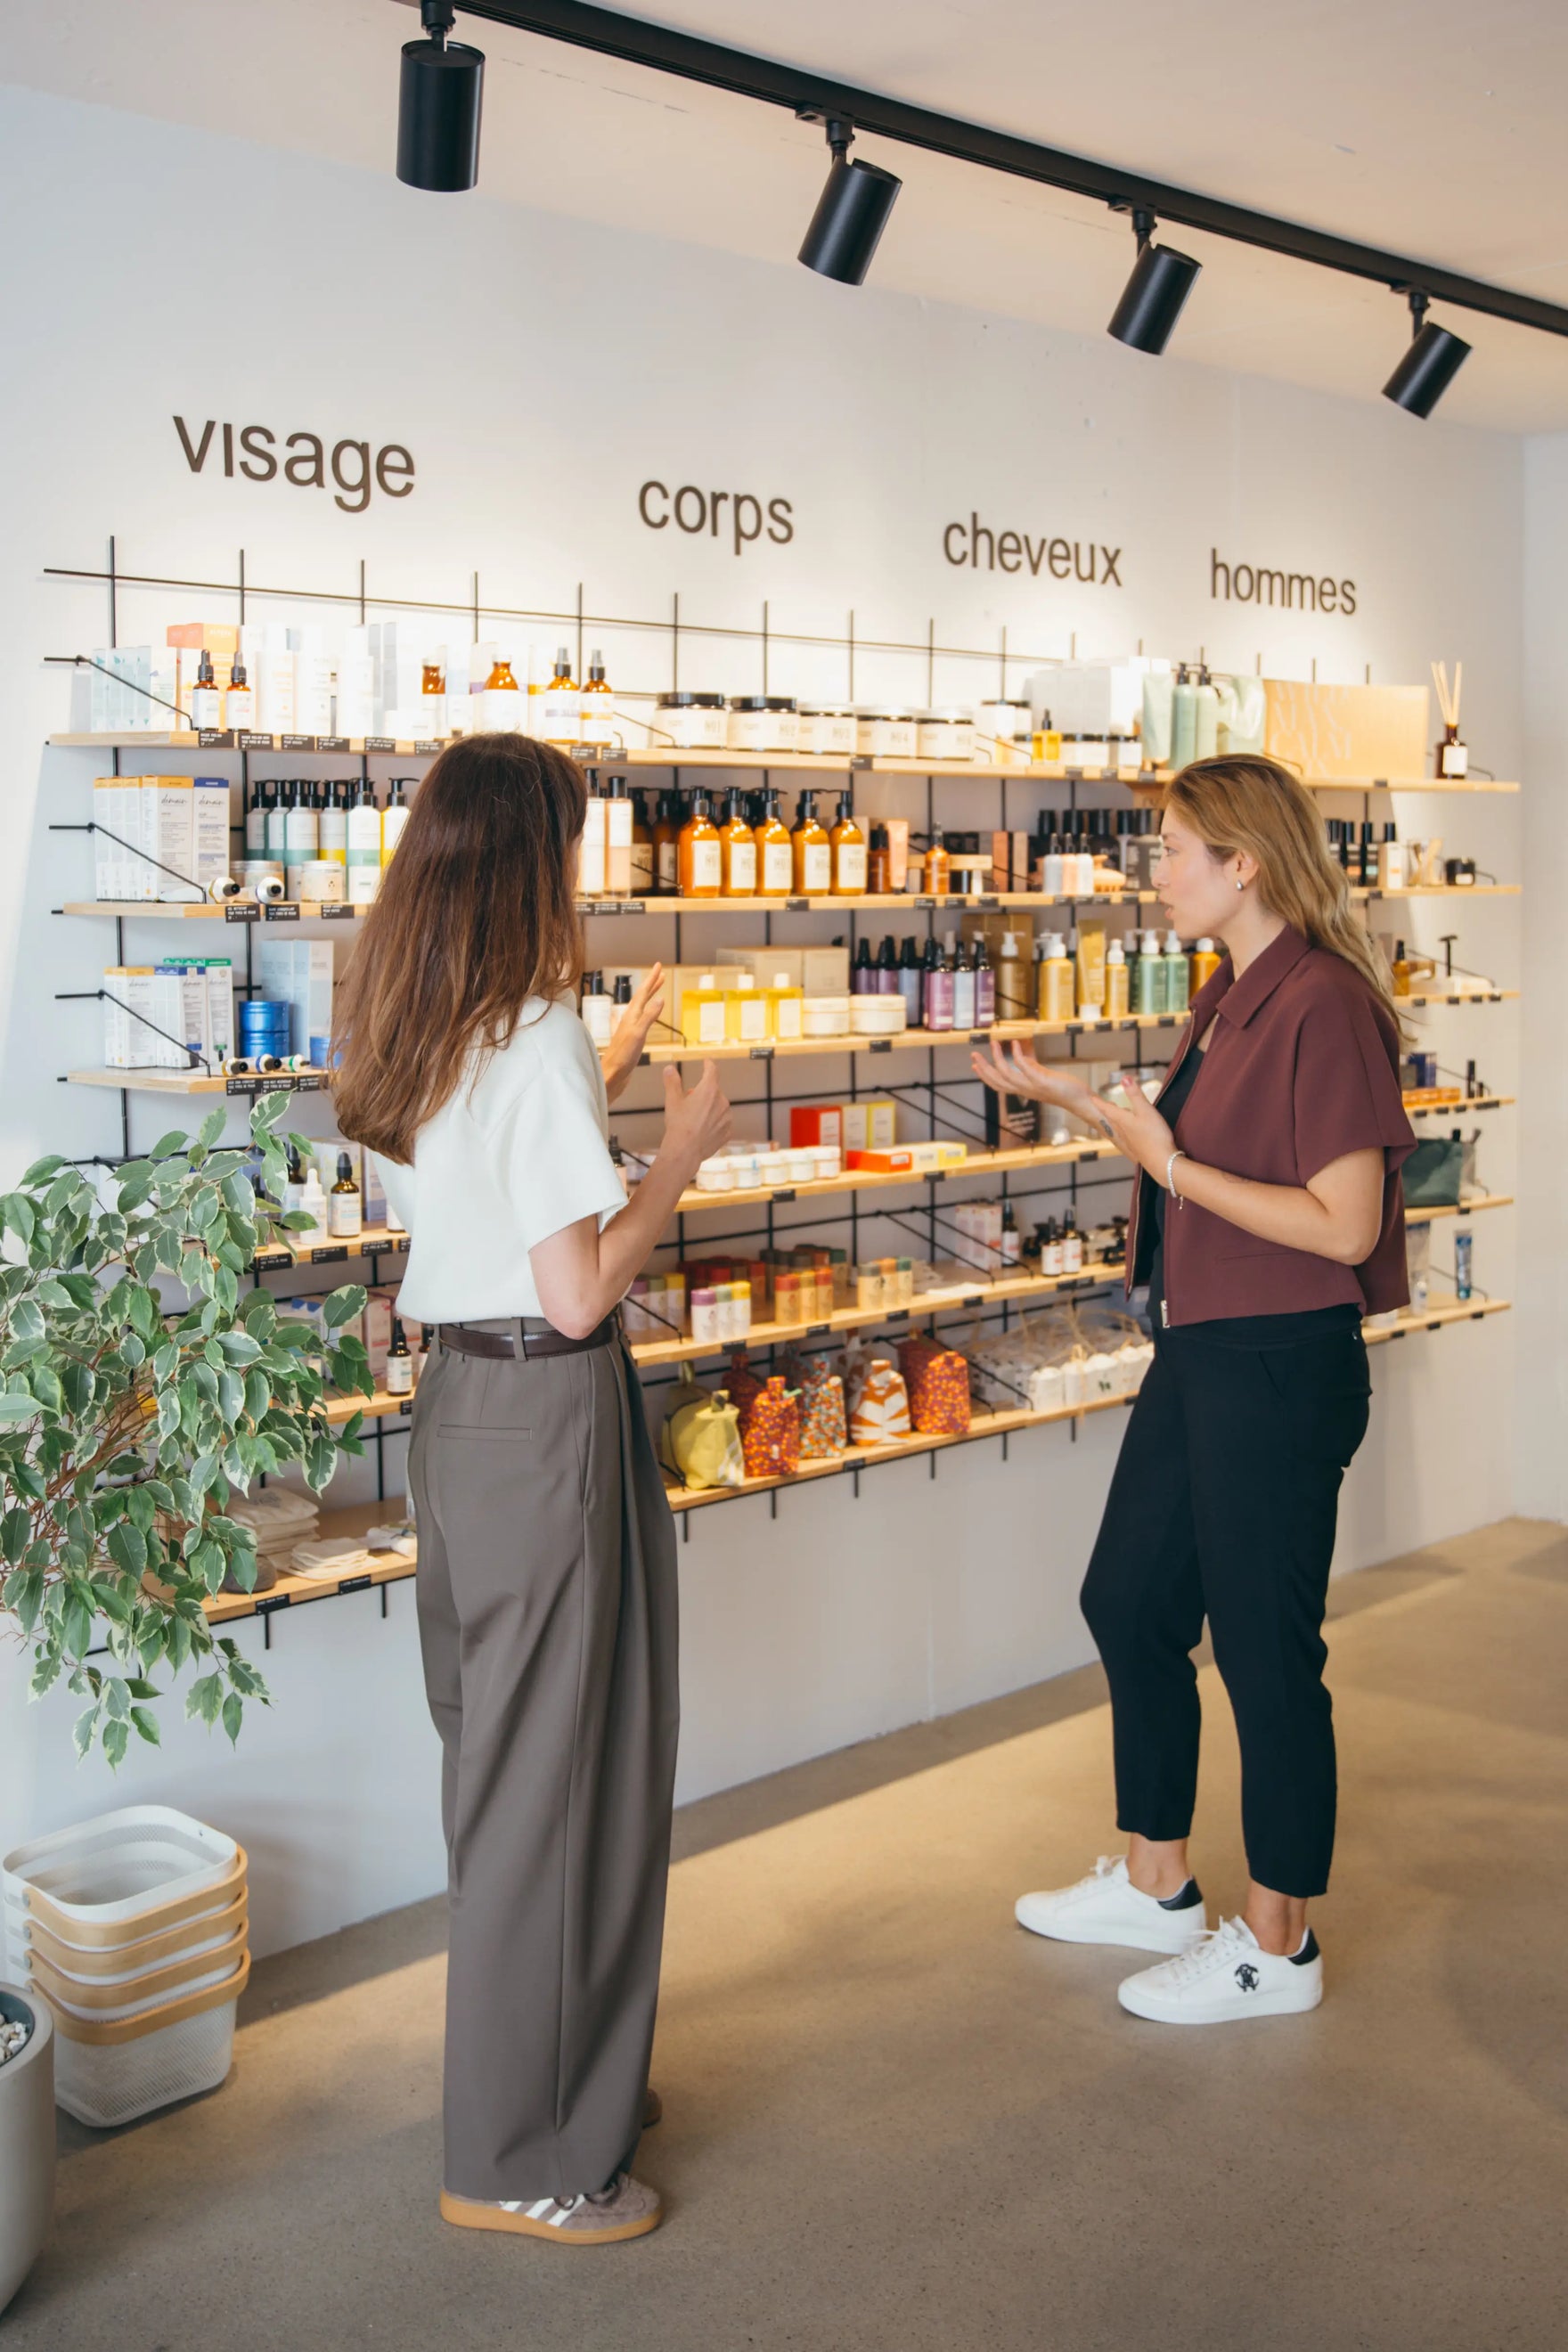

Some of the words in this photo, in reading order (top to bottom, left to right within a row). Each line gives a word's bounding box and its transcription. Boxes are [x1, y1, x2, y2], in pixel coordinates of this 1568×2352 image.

[172, 415, 415, 513] visage
[639, 480, 793, 556] corps
[943, 511, 1123, 587] cheveux
[1211, 548, 1357, 615] hommes
